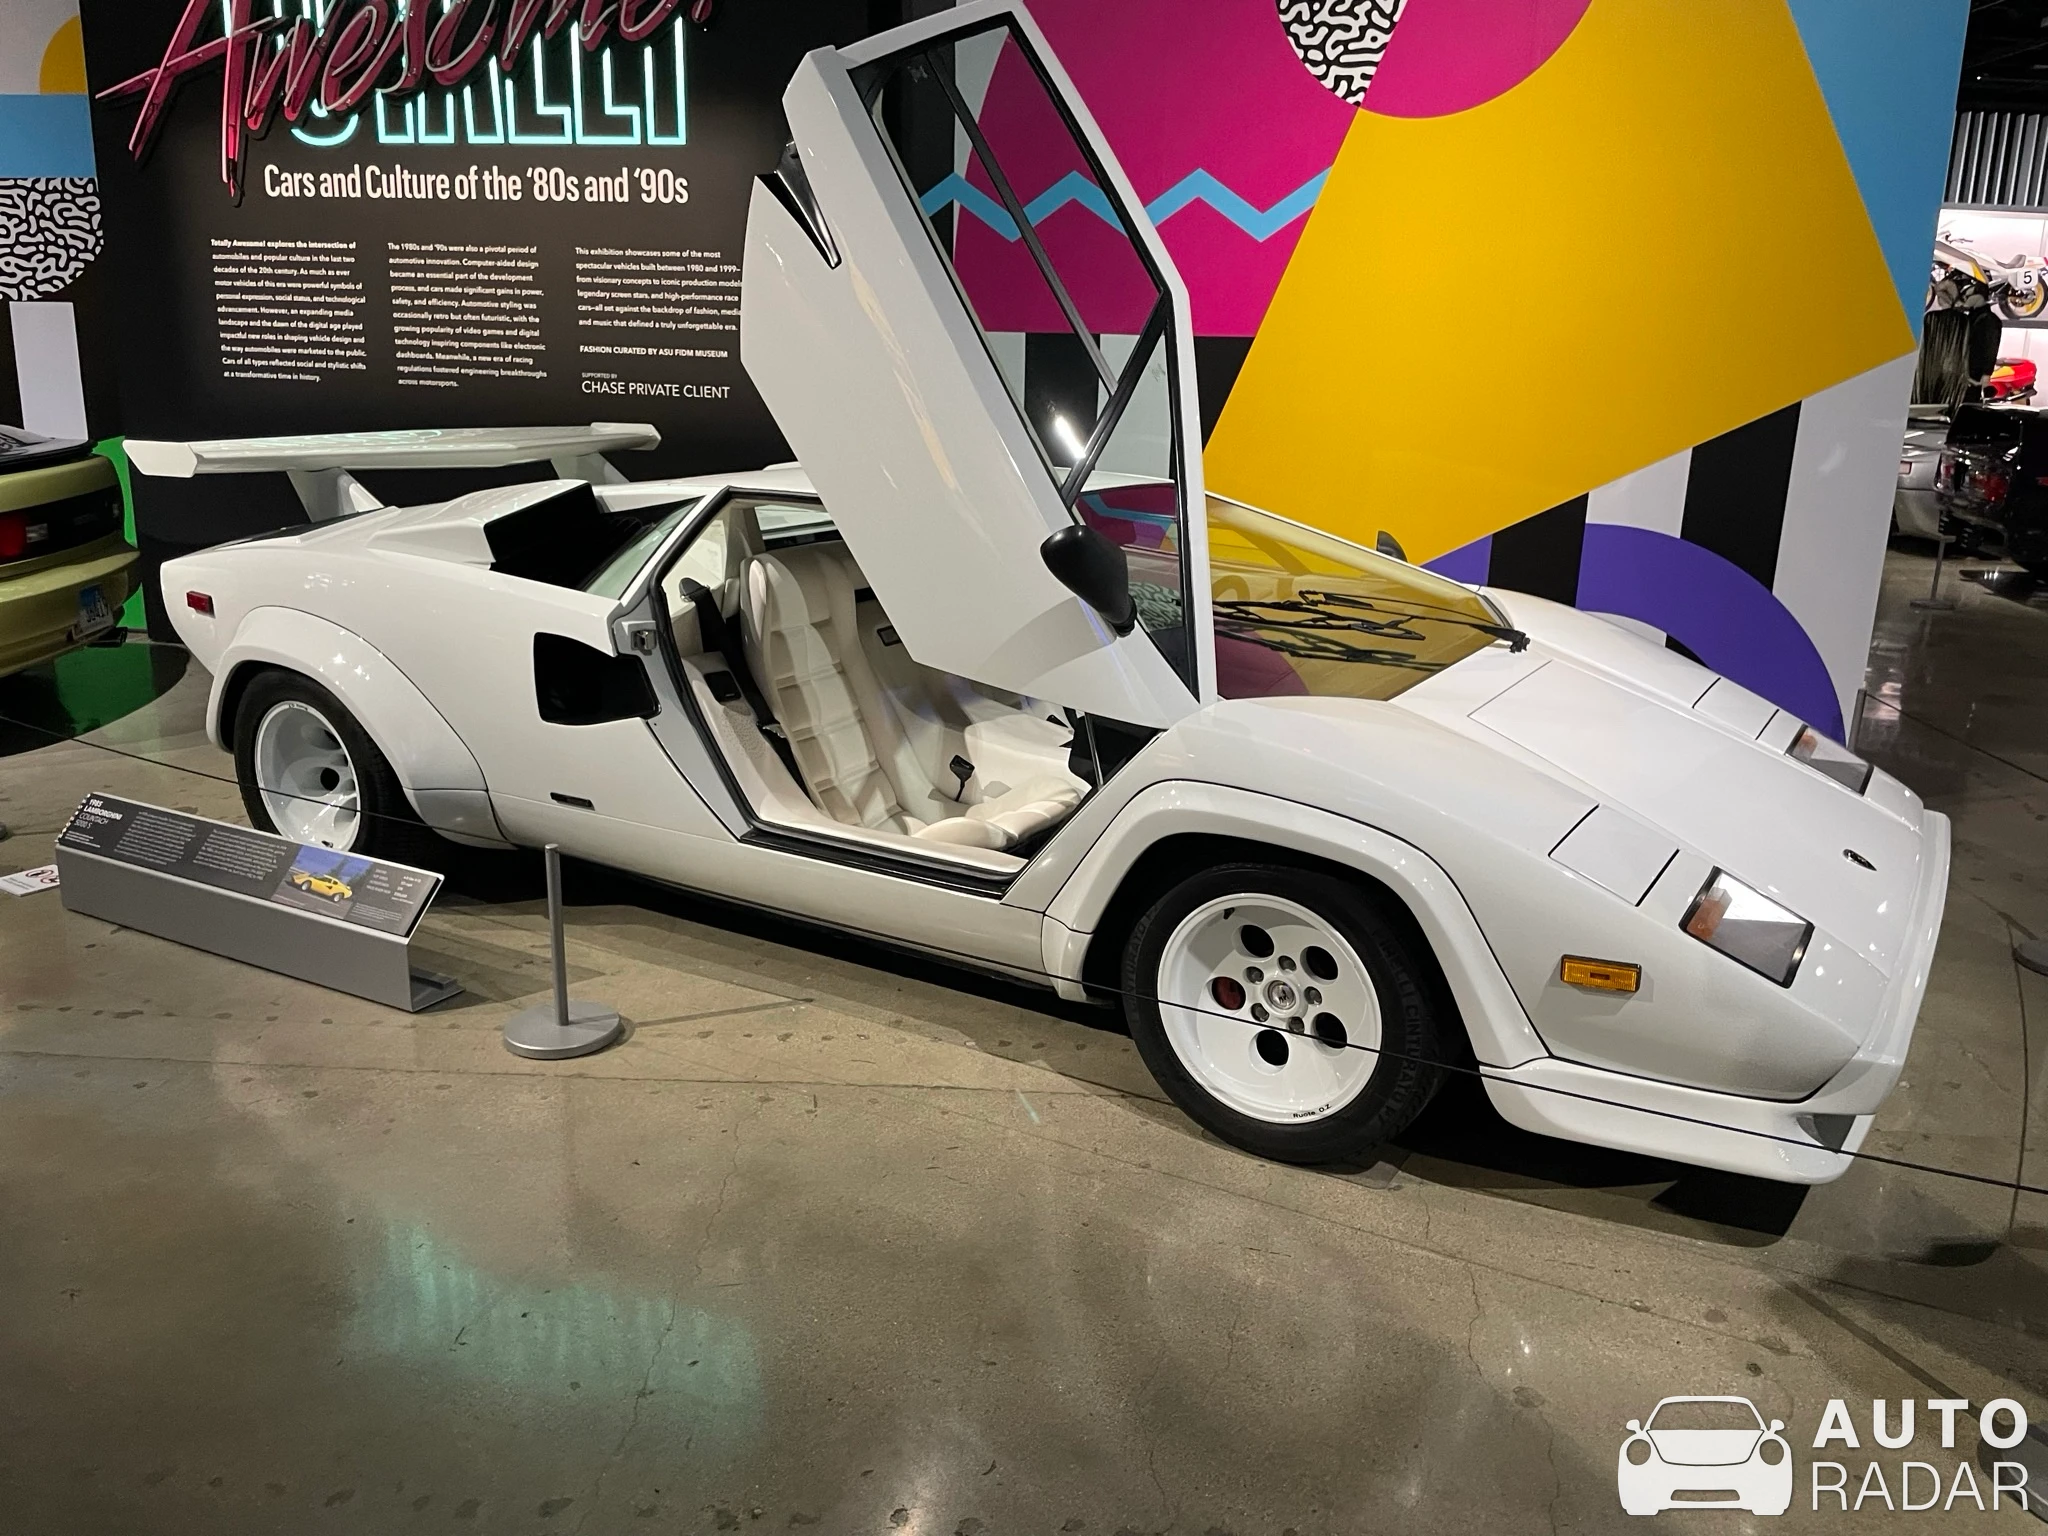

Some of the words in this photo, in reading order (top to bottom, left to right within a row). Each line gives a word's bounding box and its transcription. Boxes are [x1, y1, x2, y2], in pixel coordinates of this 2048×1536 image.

[95, 0, 713, 197] Awesom
[264, 164, 316, 197] Cars
[319, 163, 361, 198] and
[365, 163, 450, 199] Culture
[454, 165, 479, 200] of
[482, 165, 522, 201] the
[584, 166, 629, 202] and
[484, 244, 506, 254] pivotal
[507, 245, 528, 254] period
[590, 248, 623, 256] exhibition
[625, 248, 660, 257] showcases
[703, 250, 721, 258] most
[389, 256, 424, 264] automotive
[462, 258, 515, 269] Computer-aided
[516, 259, 539, 269] design
[576, 261, 612, 272] spectacular
[613, 262, 639, 270] vehicles
[657, 263, 685, 271] between
[390, 270, 415, 278] became
[425, 271, 453, 279] essential
[455, 271, 468, 281] part
[489, 272, 533, 283] development
[593, 276, 621, 286] visionary
[622, 276, 651, 287] concepts
[661, 277, 680, 286] iconic
[681, 278, 717, 288] production
[2024, 270, 2032, 284] 5
[463, 286, 495, 296] significant
[496, 286, 513, 296] gains
[577, 289, 609, 300] legendary
[664, 291, 723, 302] high-performance
[461, 299, 499, 307] Automotive
[500, 300, 522, 310] styling
[615, 304, 639, 314] against
[652, 305, 684, 316] backdrop
[393, 311, 432, 321] occasionally
[394, 324, 420, 334] growing
[421, 325, 453, 335] popularity
[482, 328, 504, 337] games
[519, 328, 539, 338] digital
[592, 319, 612, 327] music
[613, 319, 626, 327] that
[628, 320, 654, 328] defined
[660, 321, 676, 331] truly
[677, 321, 723, 332] unforgettable
[395, 337, 430, 348] technology
[460, 339, 499, 350] components
[513, 341, 546, 350] electronic
[580, 345, 611, 354] FASHION
[613, 346, 646, 355] CURATED
[695, 349, 728, 358] MUSEUM
[513, 355, 533, 365] racing
[397, 364, 432, 375] regulations
[460, 366, 499, 377] engineering
[500, 368, 547, 380] breakthroughs
[581, 381, 625, 395] CHASE
[628, 383, 680, 396] PRIVATE
[684, 384, 730, 398] CLIENT
